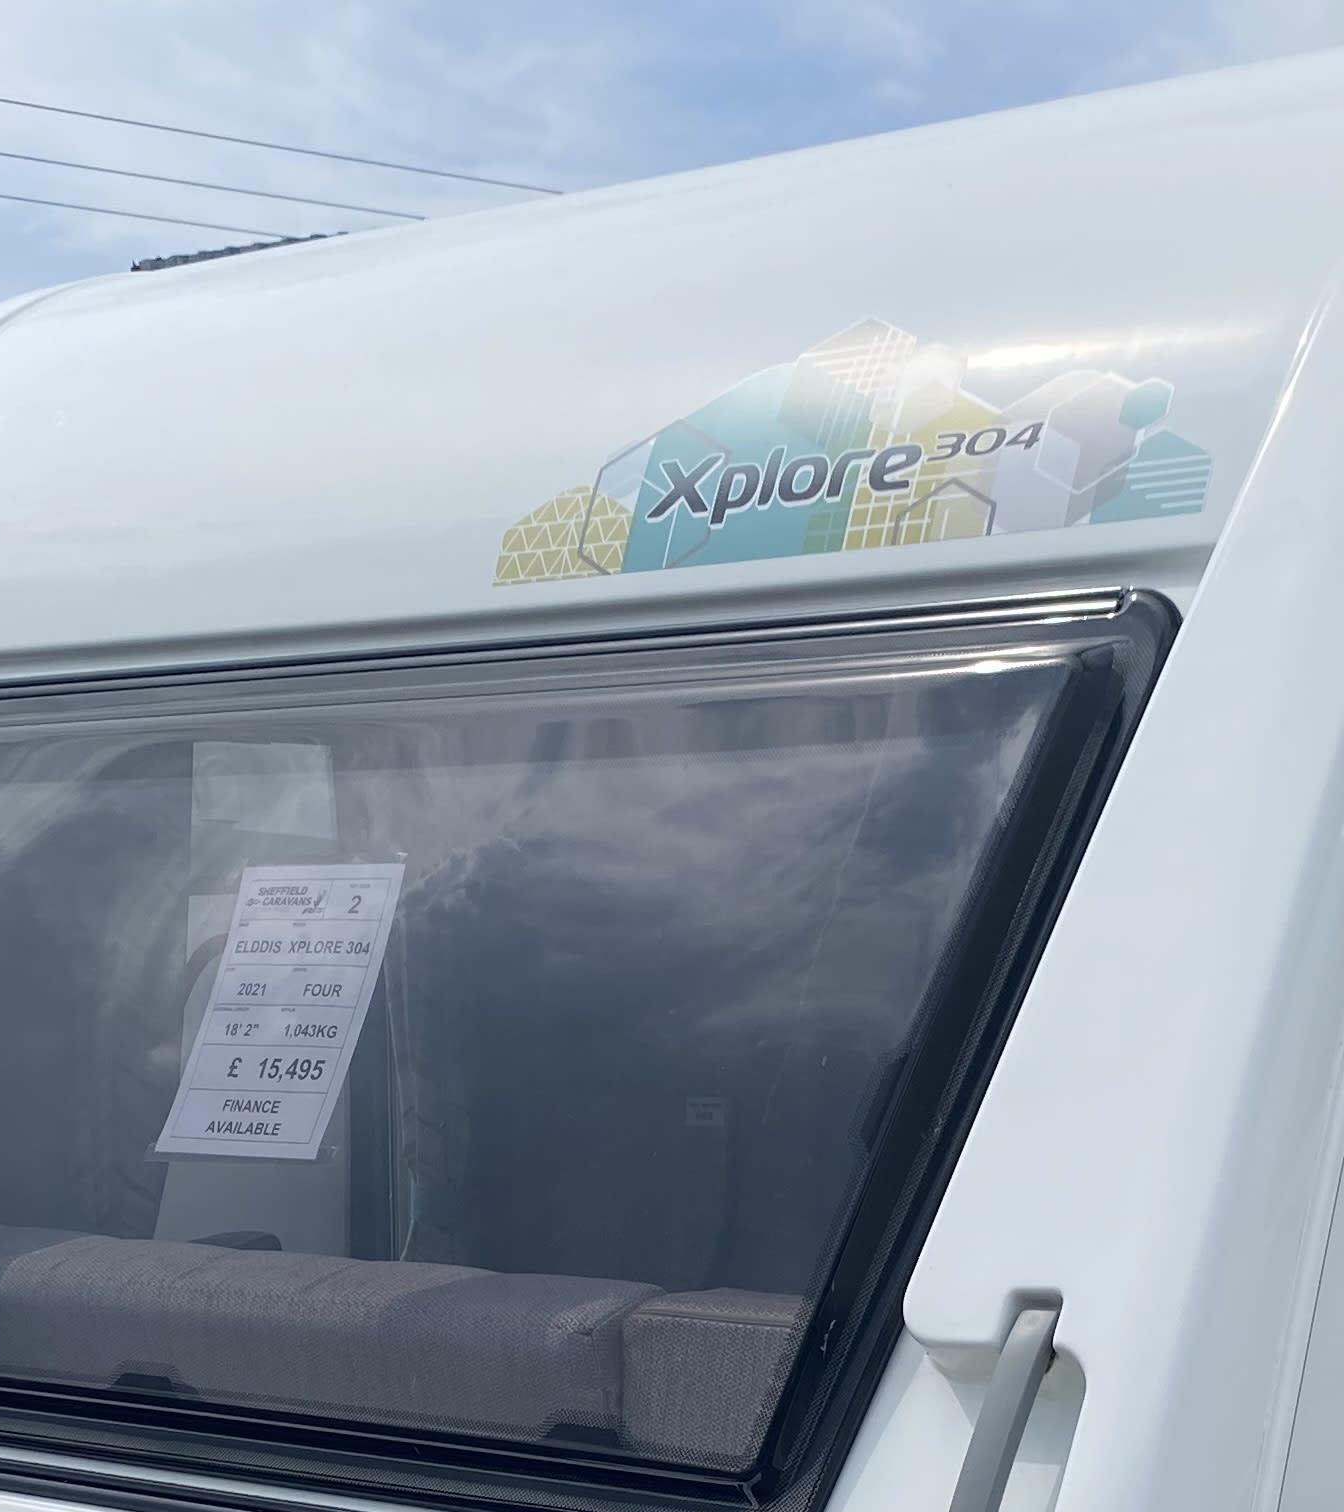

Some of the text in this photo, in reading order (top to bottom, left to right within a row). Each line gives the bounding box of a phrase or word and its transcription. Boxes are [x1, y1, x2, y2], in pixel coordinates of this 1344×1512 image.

[646, 421, 1045, 526] Xplore 304
[258, 886, 309, 896] SHEFFIELD
[262, 897, 312, 906] CARAVANS
[347, 895, 362, 914] 2
[234, 940, 371, 955] ELDDIS XPLORE 304
[237, 983, 343, 997] 2021 FOUR
[284, 1023, 338, 1039] 1,043KG
[227, 1057, 325, 1083] £ 15,495
[222, 1099, 281, 1114] FINANCE
[205, 1120, 282, 1136] AVAILABLE
